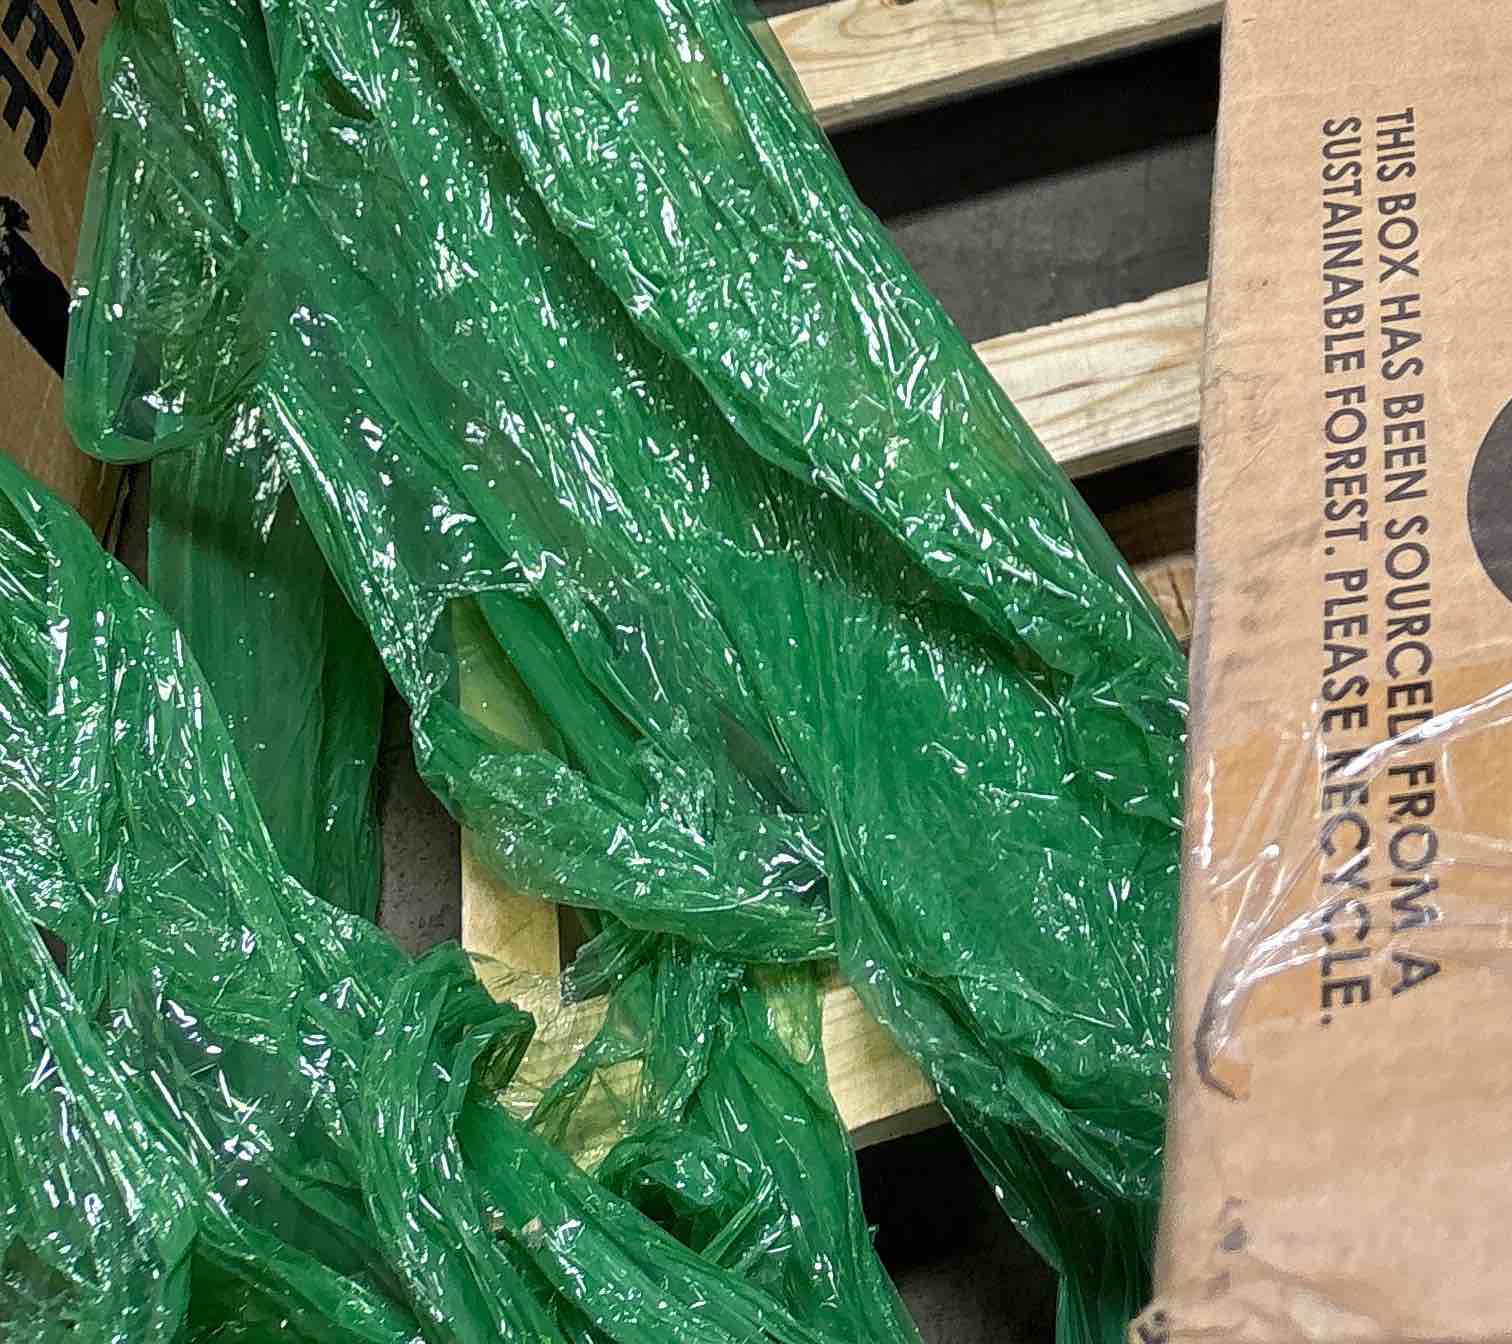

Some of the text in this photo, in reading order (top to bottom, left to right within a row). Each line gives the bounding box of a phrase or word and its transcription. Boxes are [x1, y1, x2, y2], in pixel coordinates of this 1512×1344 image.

[1322, 116, 1366, 374] SUSTAINABLE
[1324, 384, 1369, 556] FOREST.
[1376, 107, 1441, 996] THIS BOX HAS BEEN SOURCED FROM A
[1320, 568, 1370, 733] PLEASE
